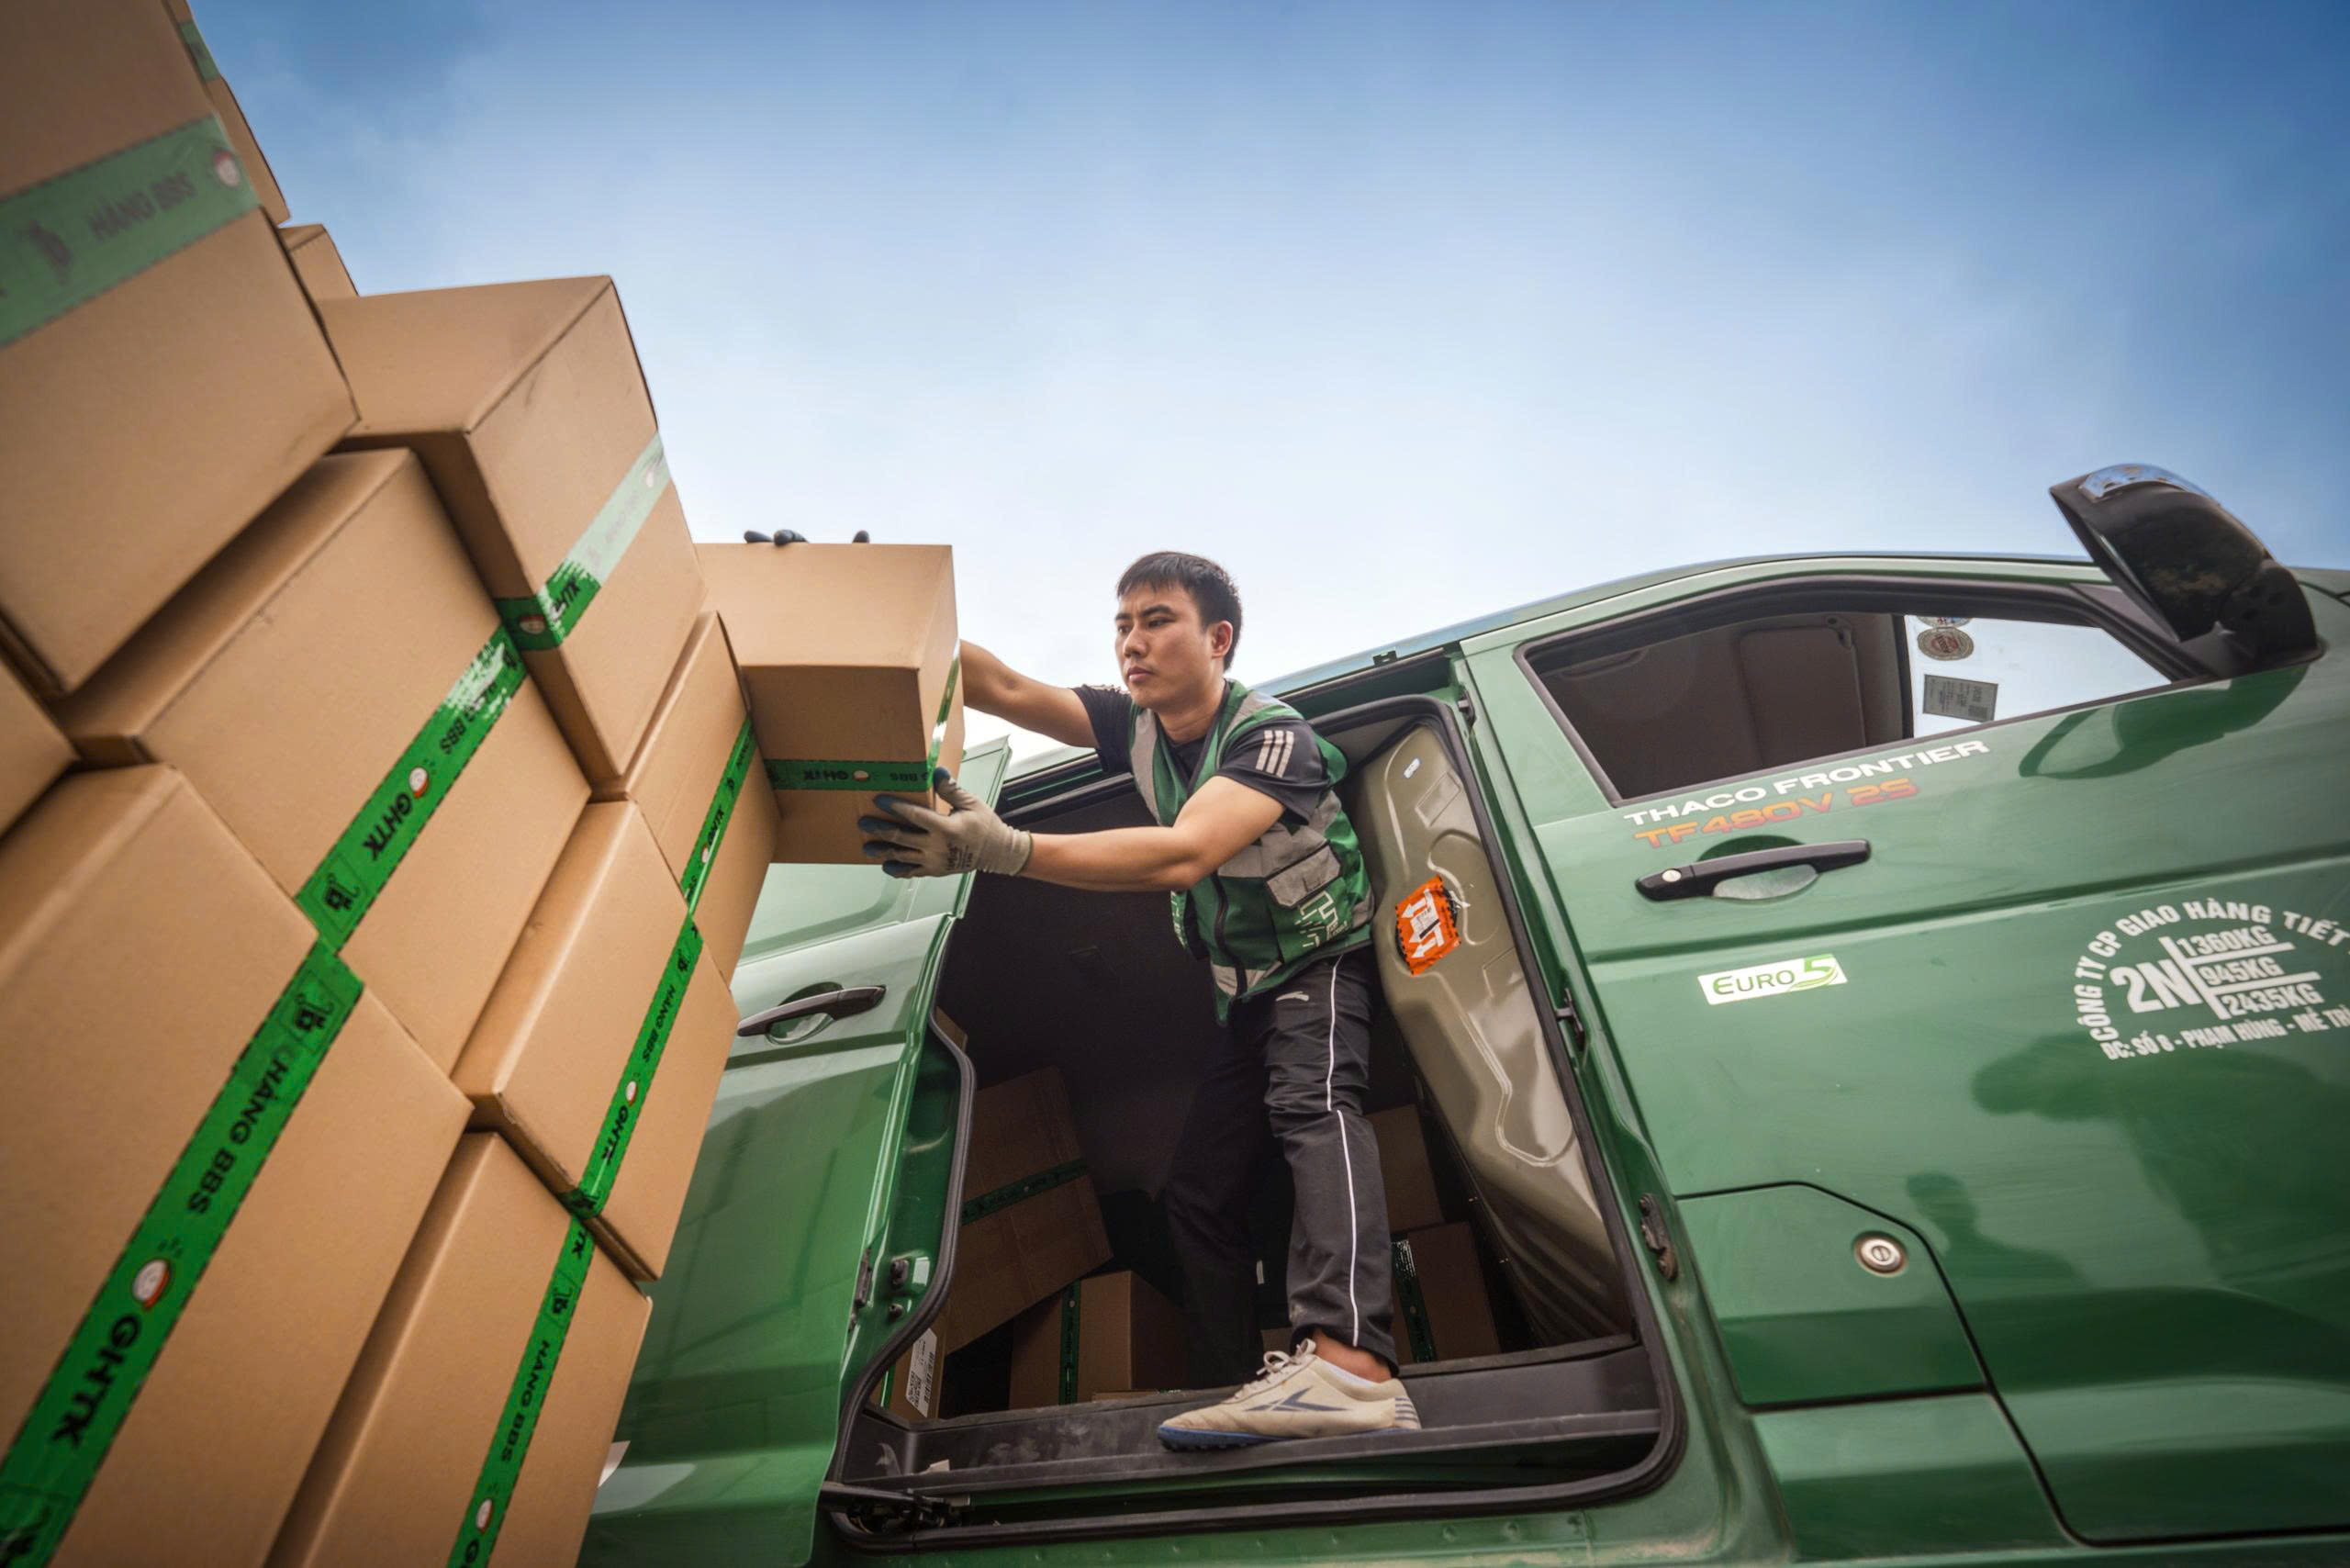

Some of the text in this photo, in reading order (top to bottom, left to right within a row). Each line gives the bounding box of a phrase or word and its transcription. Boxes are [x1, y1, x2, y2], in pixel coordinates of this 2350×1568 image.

[1624, 740, 1990, 826] THACO FRONTIER
[362, 792, 413, 861] GHTK
[2115, 904, 2181, 936] GIAO
[2182, 897, 2272, 924] HÀNG
[2087, 930, 2122, 958] CP
[2177, 925, 2277, 957] 1360KG
[1795, 953, 1839, 989] 5
[2075, 956, 2107, 980] TY
[2199, 957, 2284, 986] 945KG
[2109, 958, 2203, 1014] 2N
[2221, 983, 2324, 1016] 2435KG
[2074, 984, 2119, 1042] CÔNG
[2180, 1025, 2238, 1048] PHẠM
[601, 1104, 629, 1166] GHTK
[52, 1058, 289, 1449] HÀNG BBS GHTK
[500, 1338, 551, 1463] HÀNG BBS
